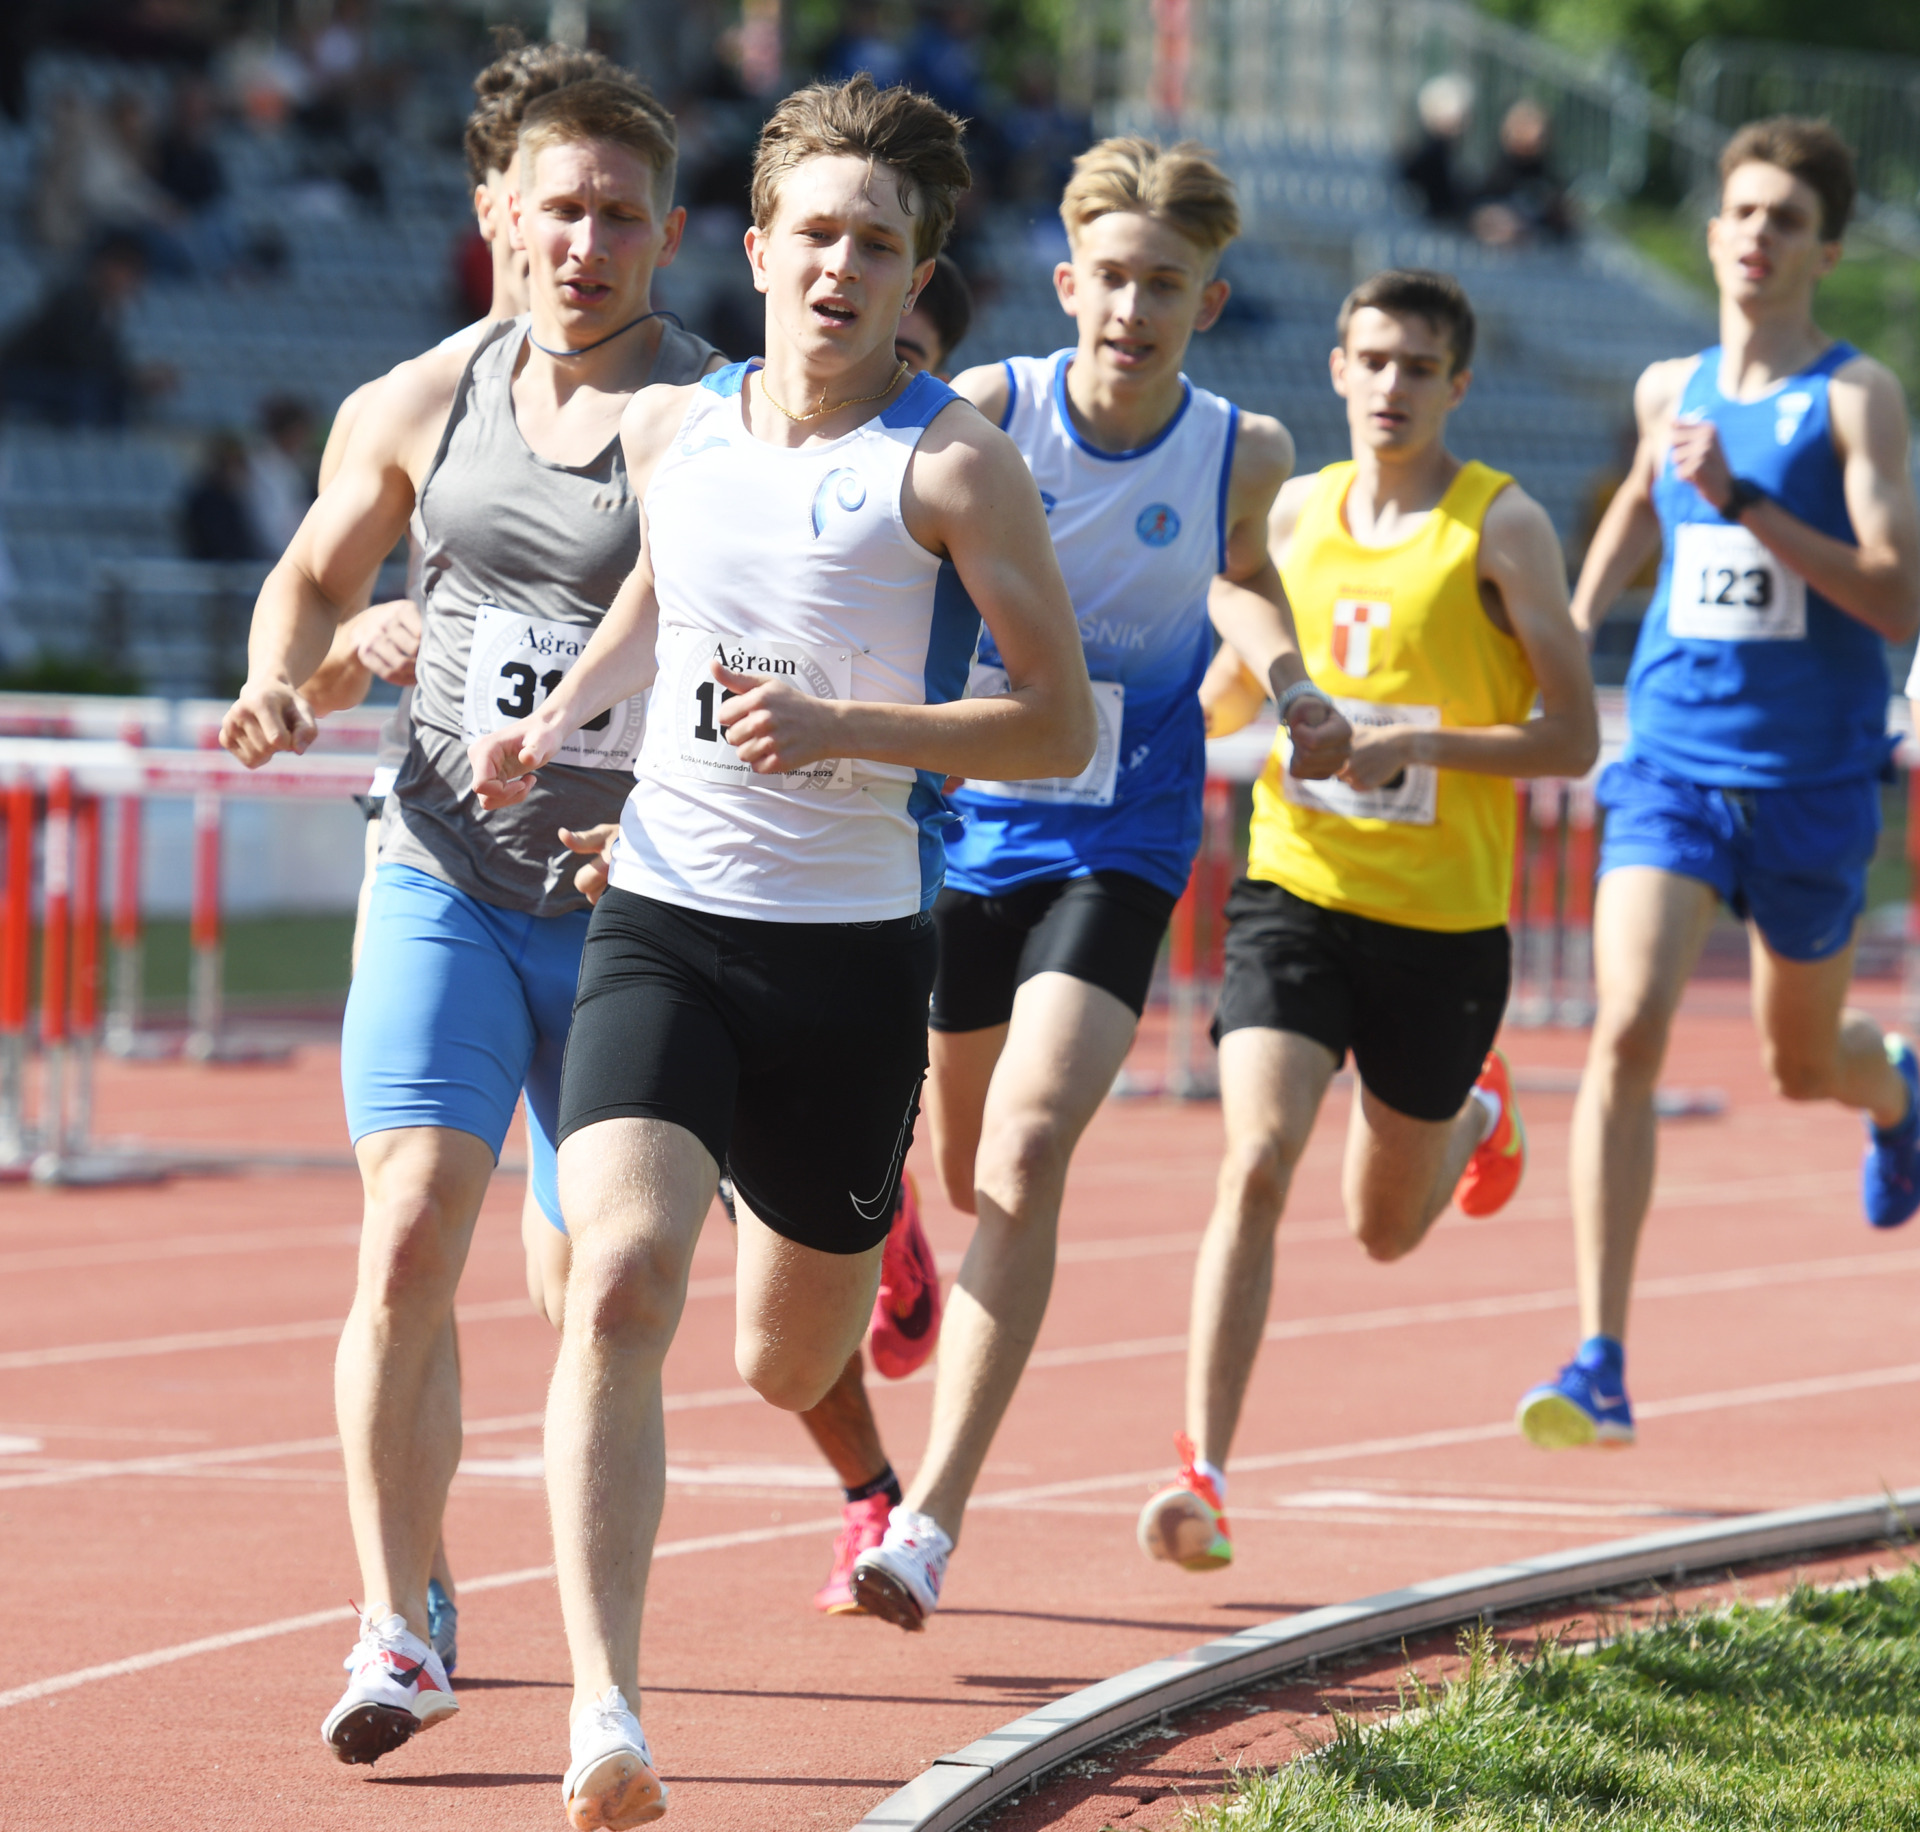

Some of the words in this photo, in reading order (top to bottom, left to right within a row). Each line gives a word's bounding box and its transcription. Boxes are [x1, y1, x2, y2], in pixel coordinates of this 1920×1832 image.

[1698, 568, 1773, 607] 123
[1079, 613, 1152, 650] ŠNIK
[713, 642, 797, 675] Agram
[610, 749, 629, 758] 2025
[813, 769, 833, 778] 2025
